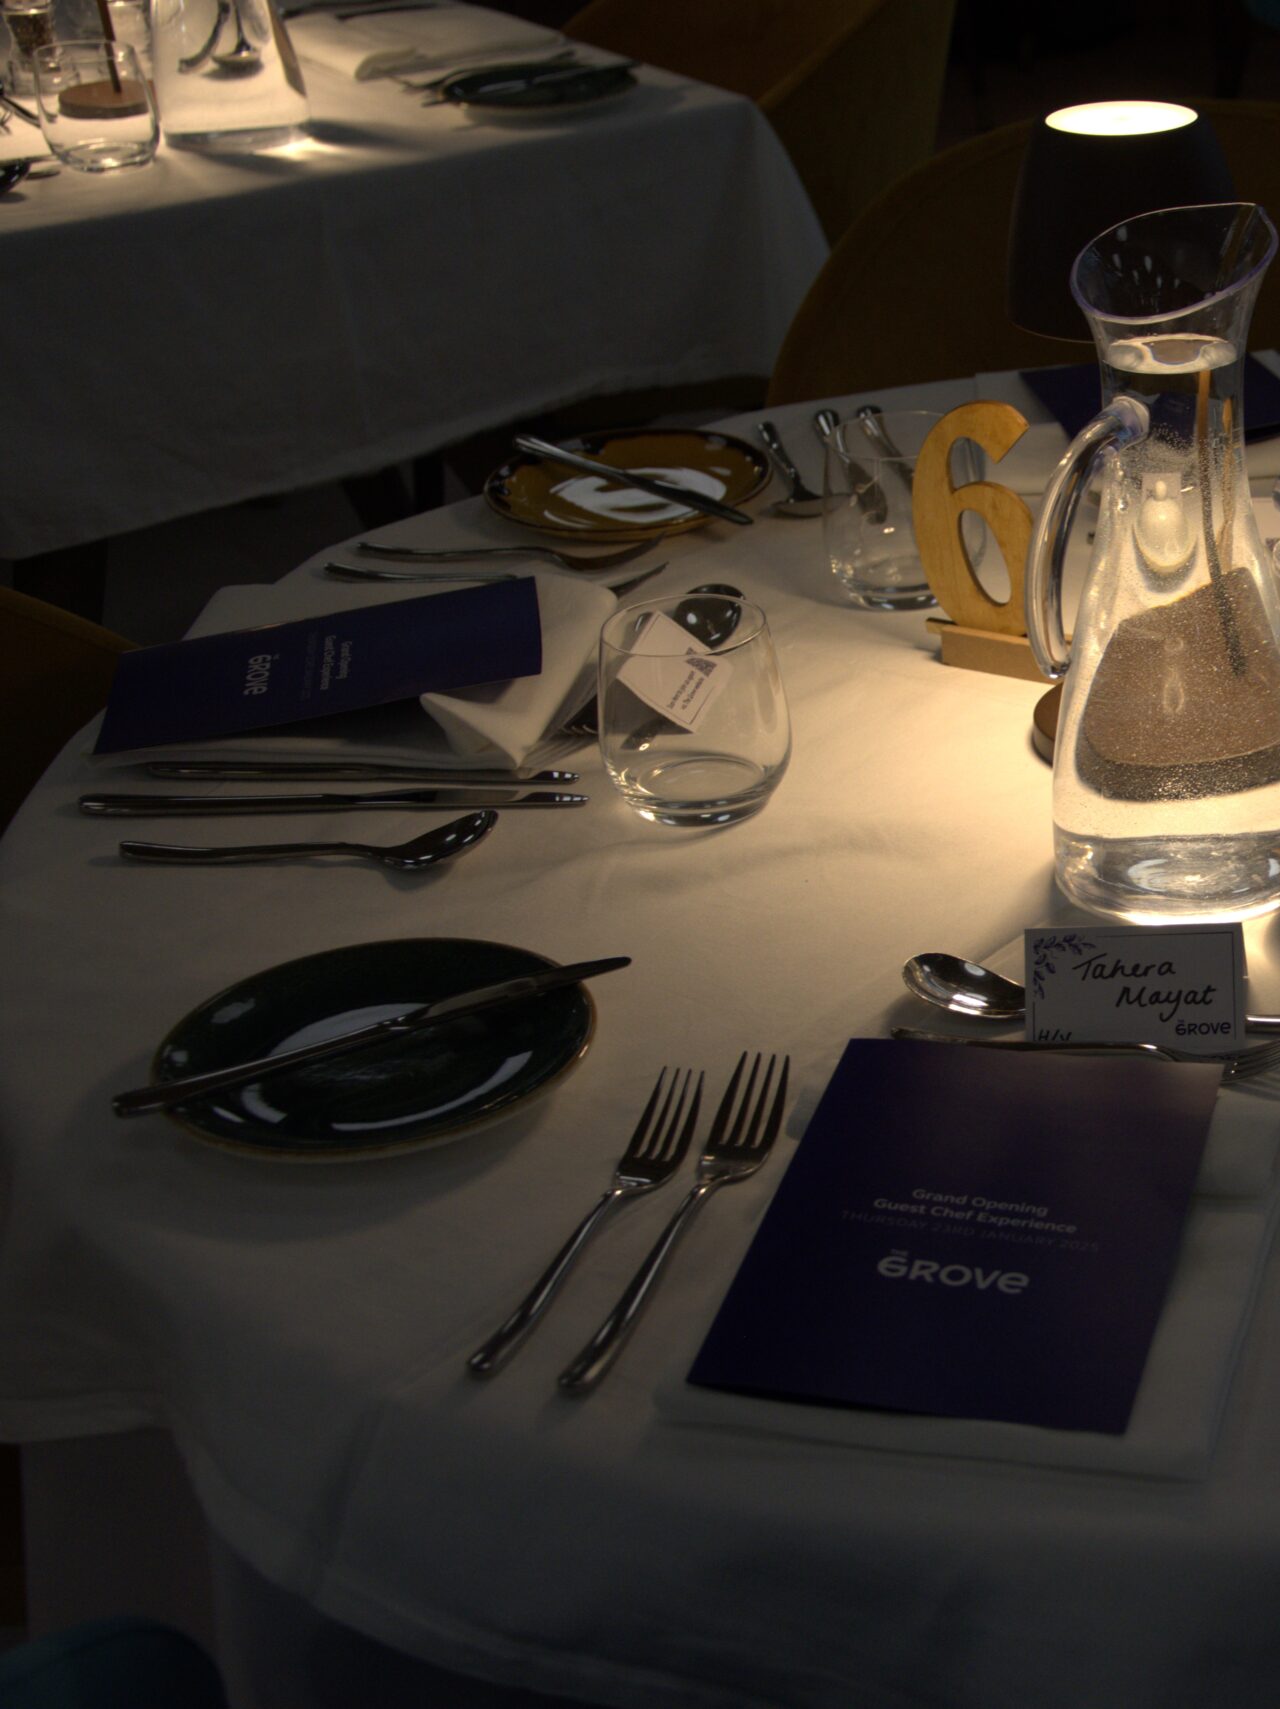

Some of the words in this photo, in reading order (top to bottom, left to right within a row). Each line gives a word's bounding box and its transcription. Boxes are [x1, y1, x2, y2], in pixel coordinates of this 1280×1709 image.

[912, 399, 1033, 637] 6
[1072, 953, 1176, 981] Tahera
[1115, 985, 1217, 1022] Mayat
[873, 1197, 928, 1217] Guest
[931, 1206, 975, 1221] Chef
[977, 1211, 1078, 1234] Experience
[912, 1187, 968, 1207] Grand
[972, 1195, 1049, 1218] Opening
[840, 1210, 928, 1231] THURSDAY
[979, 1225, 1056, 1247] JANUARY
